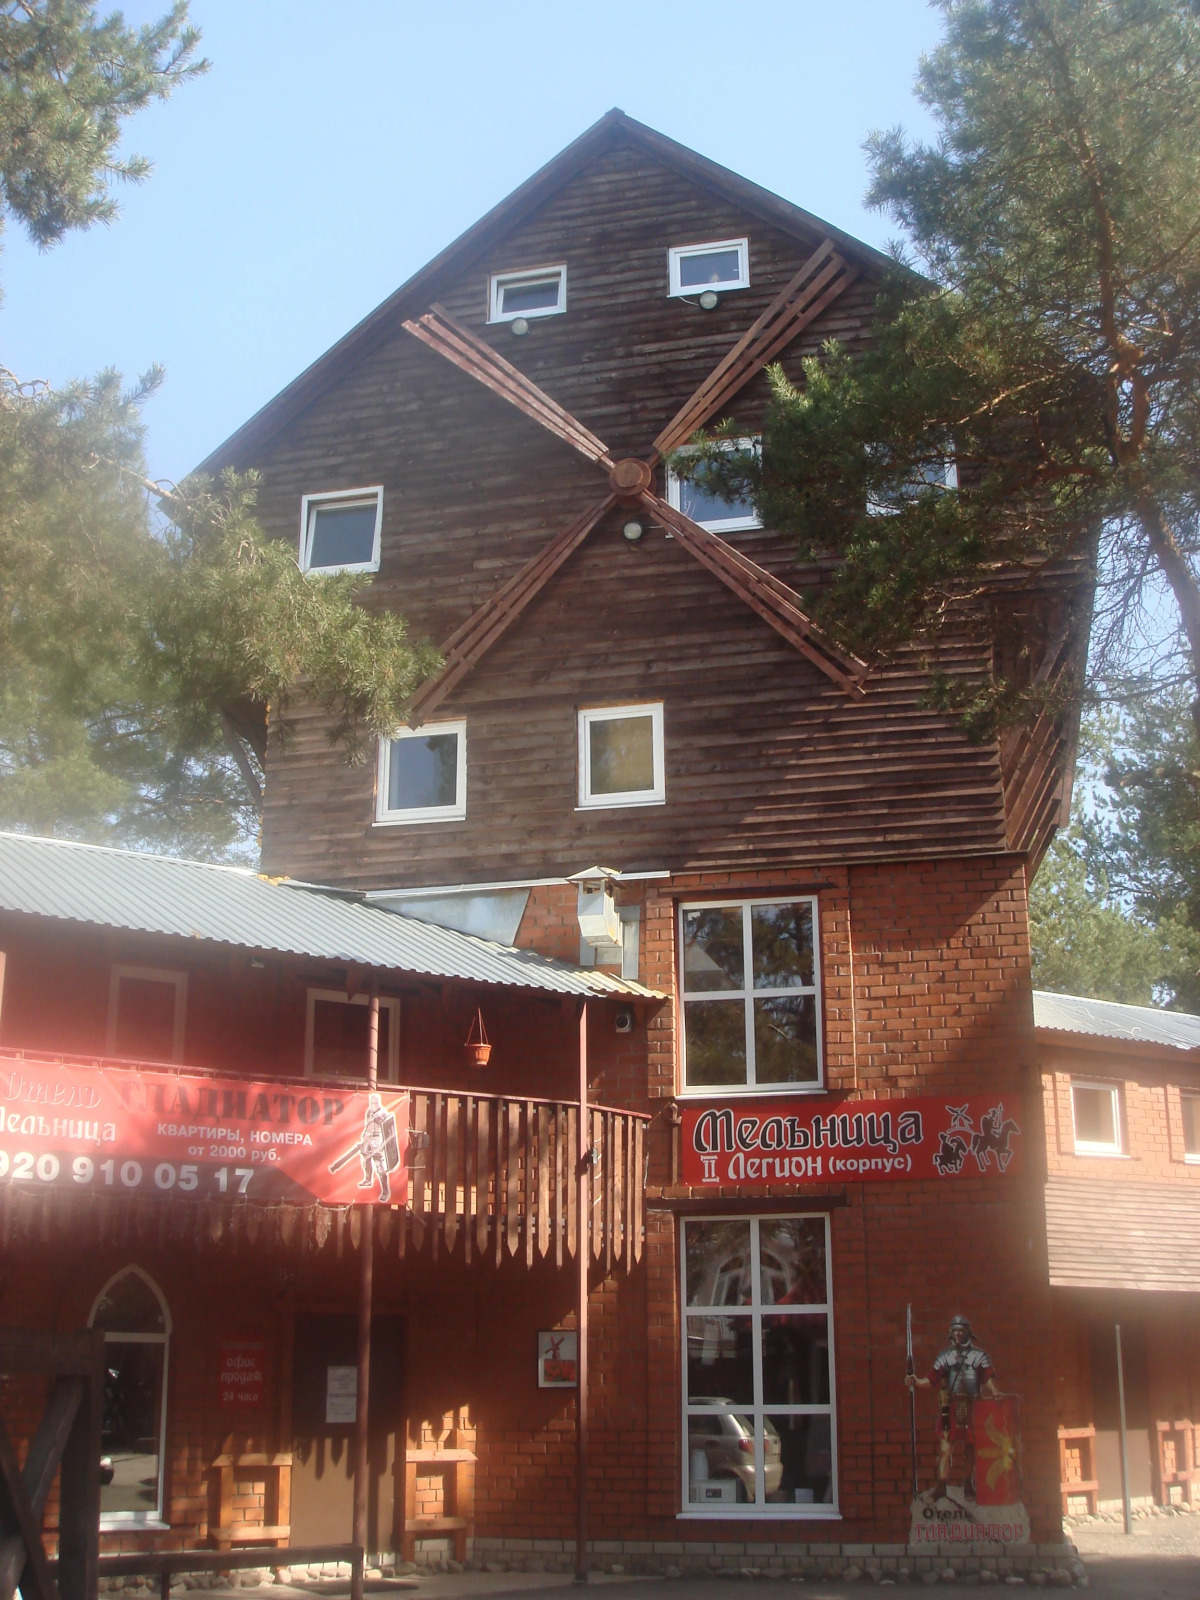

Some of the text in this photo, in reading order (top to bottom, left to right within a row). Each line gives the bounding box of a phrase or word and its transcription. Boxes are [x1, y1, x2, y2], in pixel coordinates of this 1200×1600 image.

[118, 1080, 345, 1126] ГЛАДИАТОР
[157, 1122, 313, 1147] КВАРТИРЫ, НОМЕРА
[692, 1108, 924, 1154] Мельница
[187, 1144, 281, 1163] от 2000 руб.
[727, 1151, 823, 1180] Легион
[829, 1153, 912, 1173] (корпус)
[72, 1155, 143, 1188] 910
[154, 1162, 199, 1191] 05
[214, 1167, 255, 1194] 17
[221, 1371, 262, 1384] продаж
[222, 1391, 259, 1402] 24 часа
[922, 1507, 973, 1520] Отель
